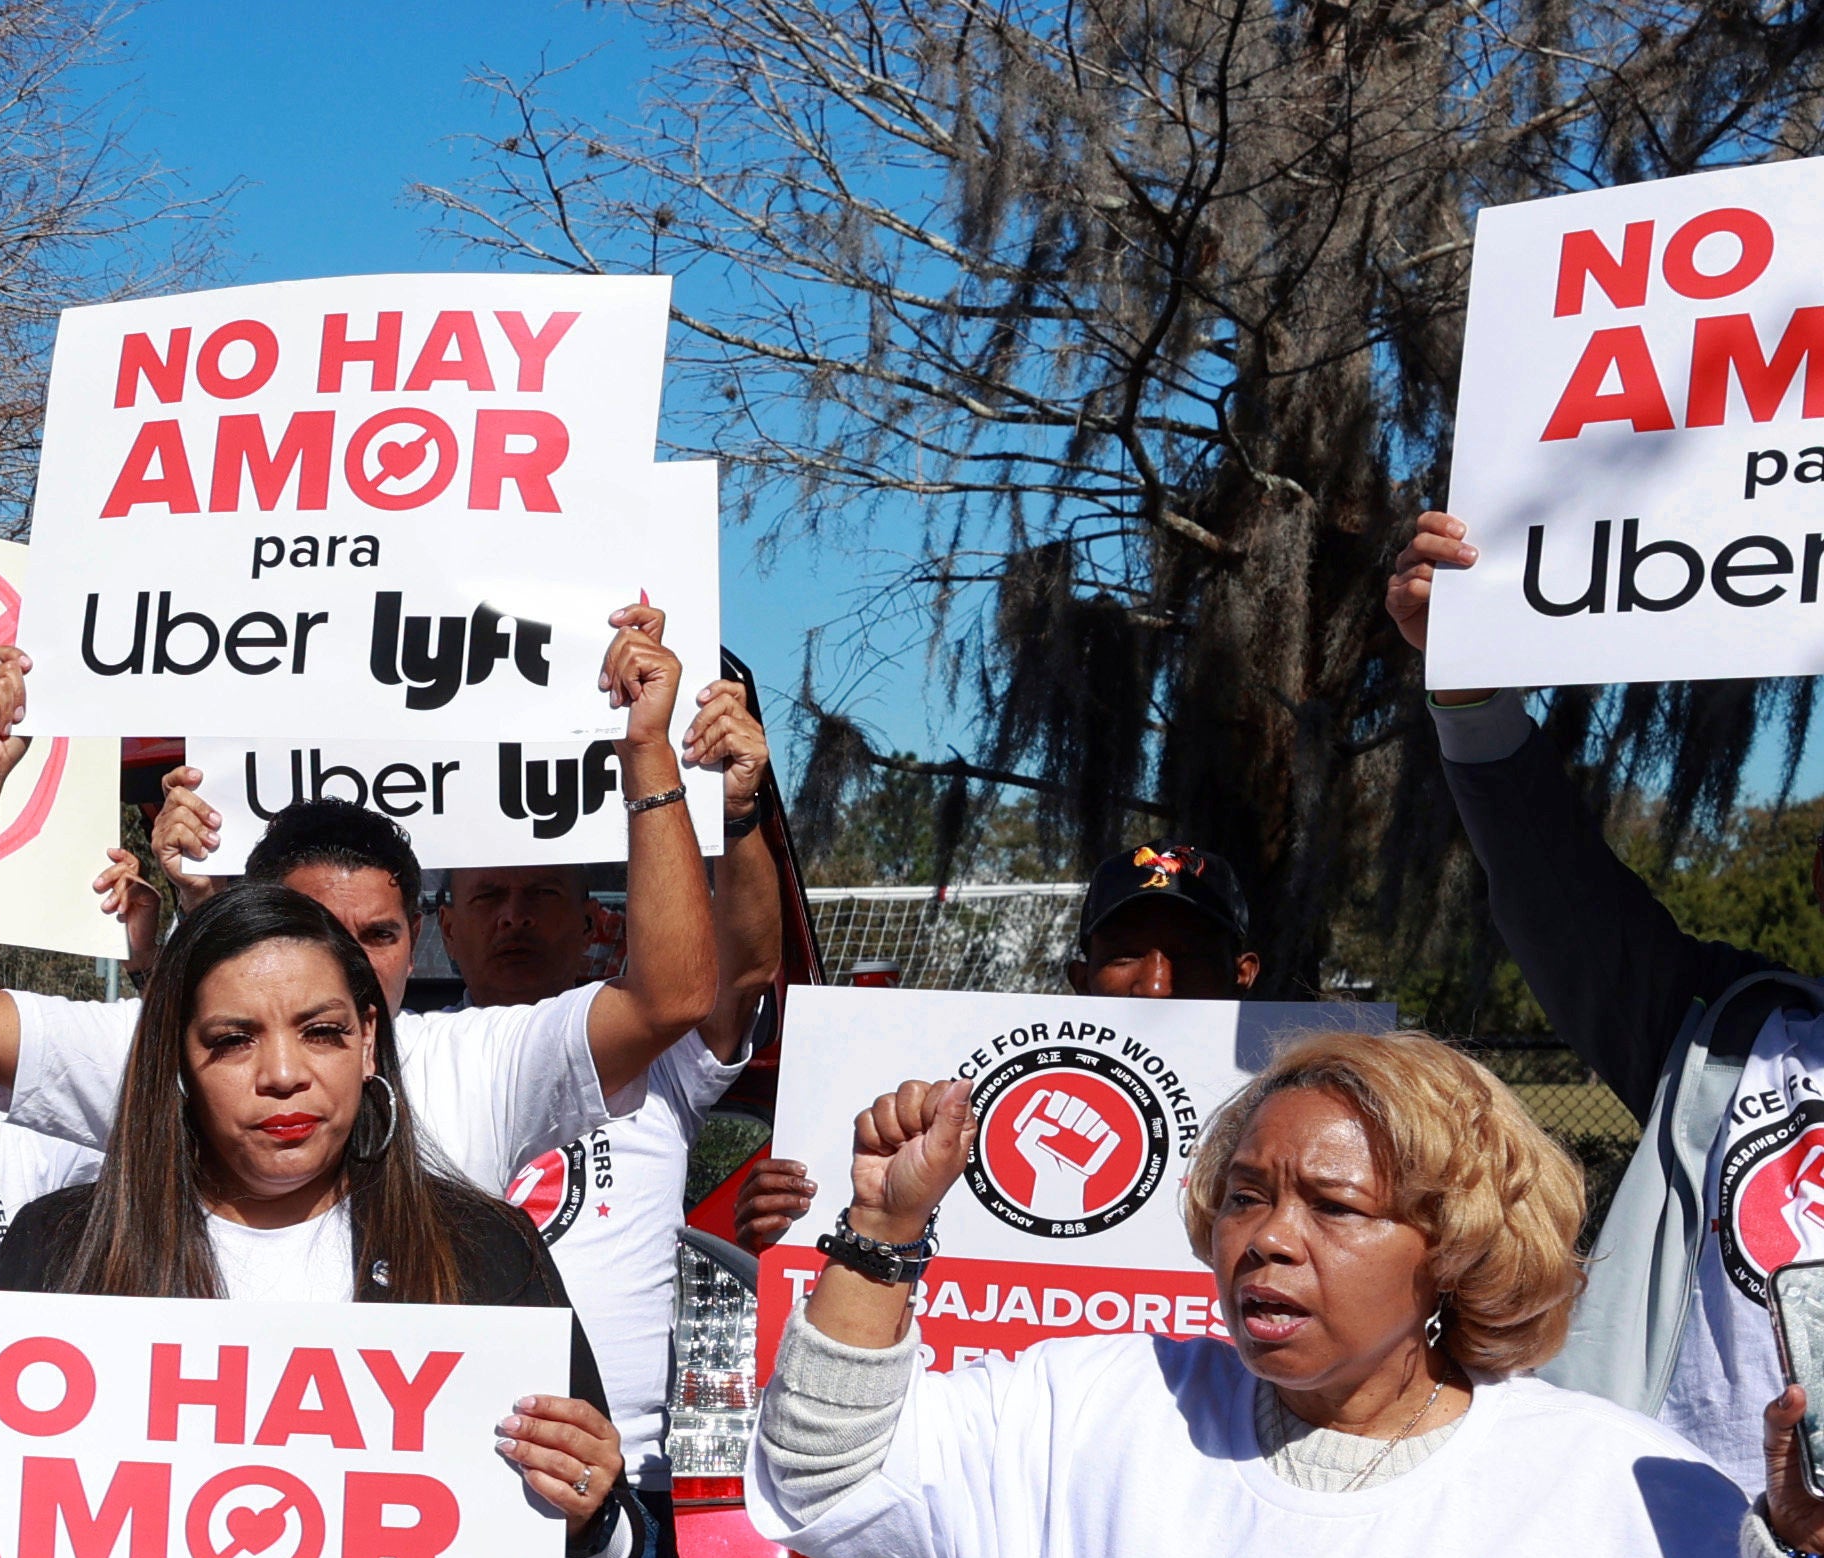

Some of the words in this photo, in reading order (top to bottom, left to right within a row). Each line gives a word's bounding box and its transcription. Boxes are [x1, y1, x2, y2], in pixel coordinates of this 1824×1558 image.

[1554, 208, 1774, 319] NO
[112, 317, 280, 407] NO
[319, 310, 580, 393] HAY
[98, 407, 570, 519] AMOR
[251, 534, 381, 579] para
[81, 589, 328, 676] Uber
[370, 591, 552, 711] lyft
[246, 748, 460, 821] Uber
[499, 741, 623, 839] lyf
[992, 1022, 1049, 1056] FOR
[1056, 1021, 1116, 1045] APP
[1121, 1037, 1202, 1160] WORKERS
[1111, 1067, 1151, 1107] JUSTICIA
[991, 1200, 1034, 1228] ADOLAT
[783, 1268, 1229, 1340] TBAJADORES
[147, 1341, 464, 1453] HAY
